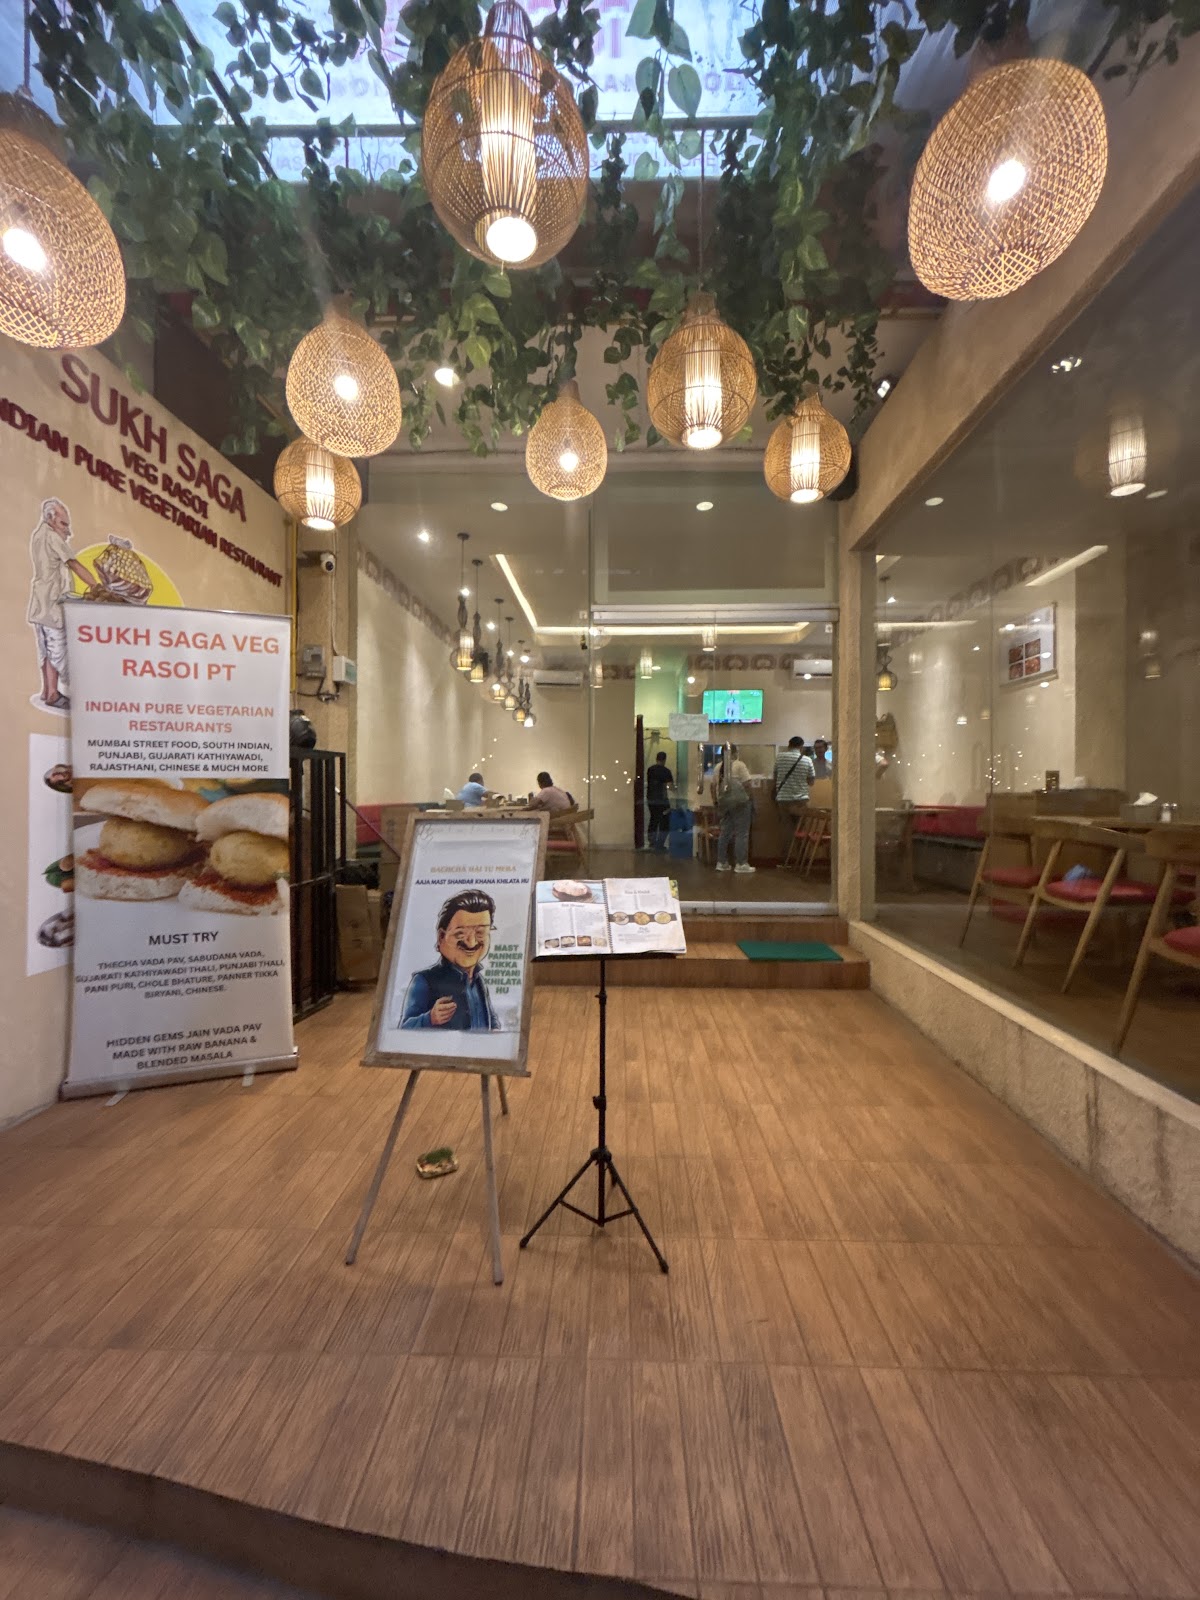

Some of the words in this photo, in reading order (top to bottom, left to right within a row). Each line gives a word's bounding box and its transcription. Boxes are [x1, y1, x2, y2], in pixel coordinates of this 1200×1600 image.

[60, 353, 167, 464] SUKH
[177, 443, 247, 523] SAGA
[120, 444, 159, 485] VEG
[162, 473, 209, 519] RASOI
[74, 444, 126, 493] PURE
[129, 479, 218, 548] VEGETARIAN
[219, 537, 283, 588] RESTAURANT
[77, 625, 150, 646] SUKH
[159, 630, 226, 650] SAGA
[232, 634, 280, 654] VEG
[122, 659, 199, 680] RASOI
[207, 664, 236, 681] PT
[85, 701, 140, 713] INDIAN
[145, 703, 183, 715] PURE
[187, 704, 275, 718] VEGETARIAN
[129, 720, 233, 733] RESTAURANTS
[87, 739, 131, 748] MUMBAI
[133, 740, 168, 749] STREET
[171, 741, 200, 750] FOOD,
[203, 741, 235, 750] SOUTH
[237, 742, 273, 751] INDIAN,
[98, 751, 146, 761] PUNJABI,
[148, 752, 195, 761] GUJARATI
[198, 752, 263, 762] KATHIYAWADI,
[89, 763, 157, 772] RAJASTHANI,
[159, 764, 200, 772] CHINESE
[202, 764, 208, 772] &
[211, 764, 240, 772] MUCH
[242, 764, 269, 772] MORE
[148, 934, 189, 946] MUST
[193, 931, 219, 943] TRY
[97, 960, 139, 970] THECHA
[140, 958, 164, 966] VADA
[167, 956, 186, 964] PAV,
[187, 952, 237, 963] SABUDANA
[238, 950, 265, 959] VADA,
[76, 972, 122, 983] GUJARATI
[124, 966, 187, 979] KATHIYAWADI
[189, 965, 217, 974] THALI,
[219, 961, 257, 971] PUNJABI
[258, 959, 286, 968] THALI,
[84, 984, 108, 994] PANI
[110, 982, 136, 991] PURI,
[138, 979, 169, 989] CHOLE
[171, 974, 216, 986] BHATURE,
[217, 972, 252, 982] PANNER
[254, 970, 278, 979] TIKKA
[495, 986, 509, 994] HU
[144, 988, 184, 999] BIRYANI,
[106, 1035, 151, 1048] HIDDEN
[153, 1031, 184, 1042] GEMS
[187, 1029, 210, 1039] JAIN
[212, 1026, 241, 1035] VADA
[242, 1022, 263, 1032] PAV
[112, 1048, 144, 1060] MADE
[147, 1045, 176, 1056] WITH
[178, 1042, 202, 1053] RAW
[204, 1036, 248, 1049] BANANA
[249, 1035, 257, 1044] &
[136, 1056, 188, 1070] BLENDED
[190, 1050, 233, 1063] MASALA
